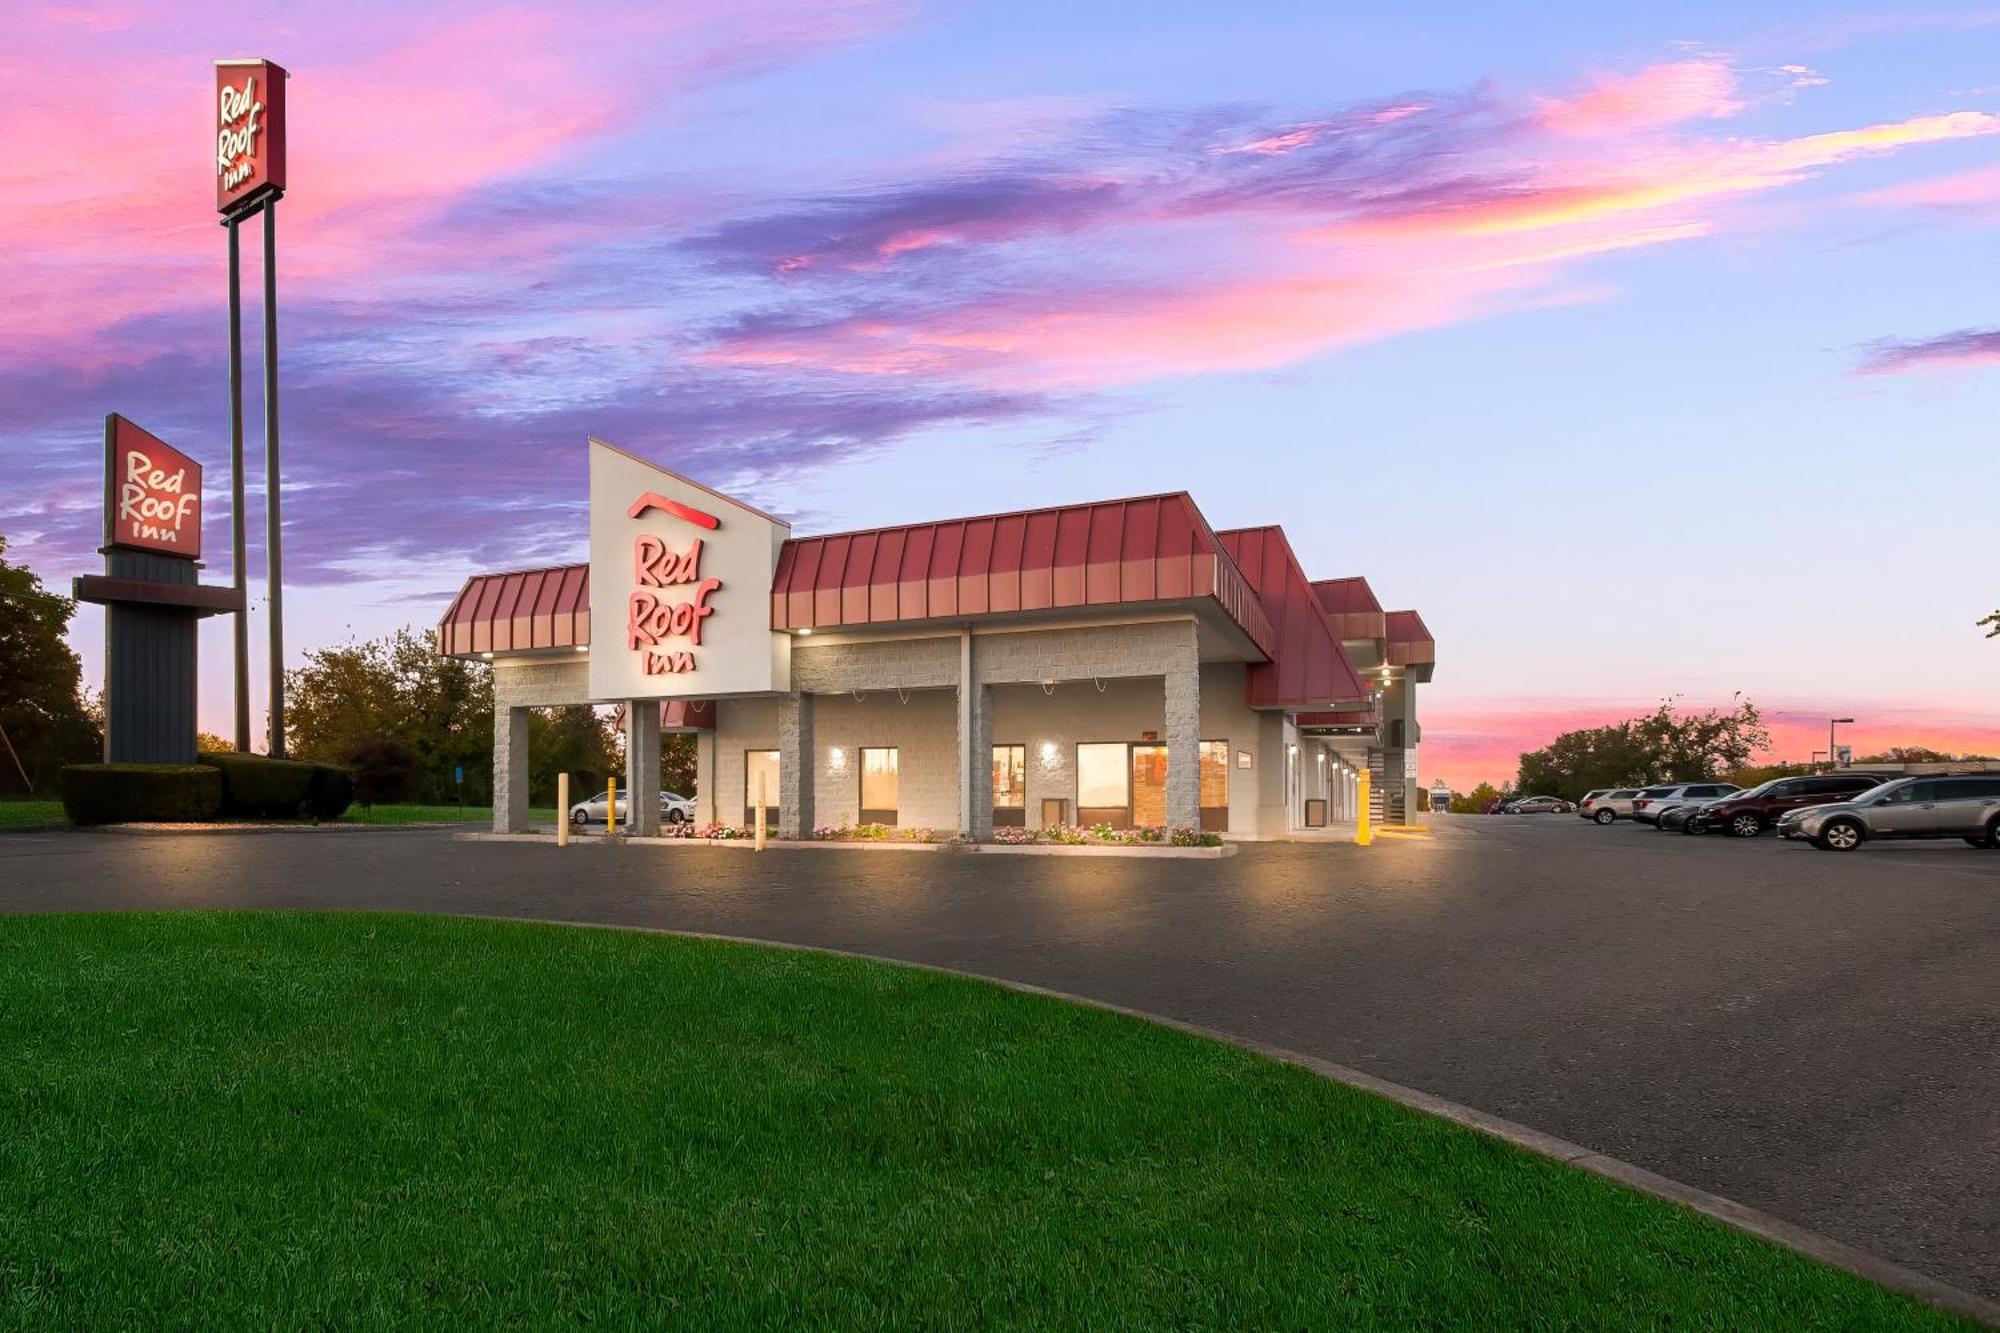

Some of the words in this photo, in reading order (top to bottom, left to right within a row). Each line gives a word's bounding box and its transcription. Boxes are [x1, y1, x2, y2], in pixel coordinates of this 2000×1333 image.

[221, 76, 255, 125] Red
[218, 102, 263, 175] Roof
[224, 161, 253, 191] Inn
[127, 451, 185, 493] Red
[119, 483, 198, 530] Roof
[132, 522, 176, 542] Inn
[634, 534, 704, 588] Red
[627, 578, 722, 650] Roof
[642, 651, 696, 675] Inn
